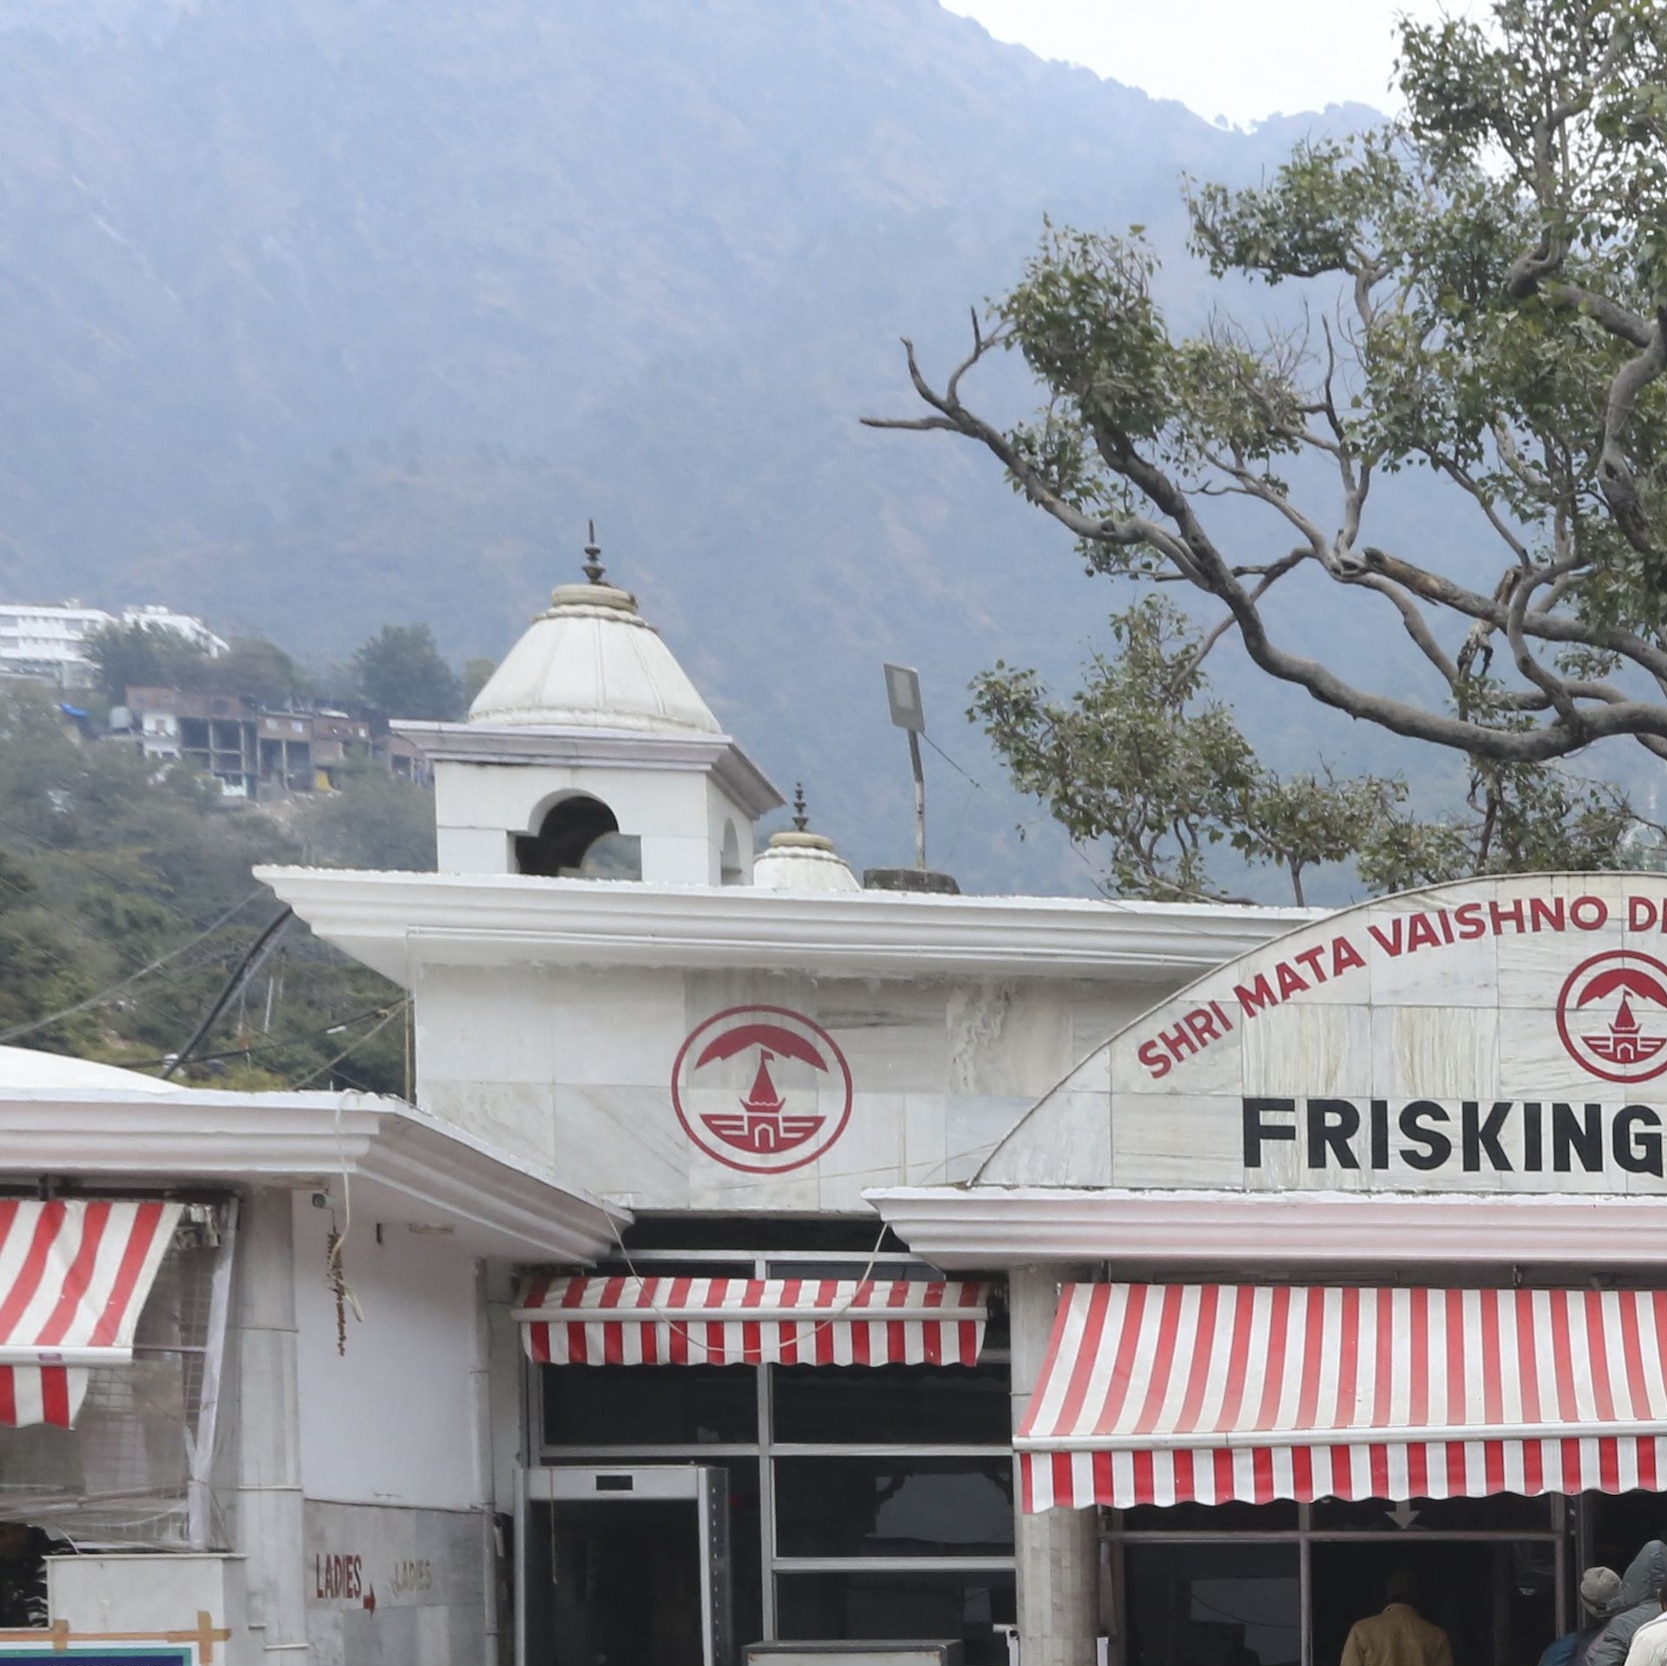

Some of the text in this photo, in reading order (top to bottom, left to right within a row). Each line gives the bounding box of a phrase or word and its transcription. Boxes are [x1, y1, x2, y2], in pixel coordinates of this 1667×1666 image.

[1138, 1001, 1232, 1079] SHRI
[1234, 936, 1365, 1018] MATA
[1368, 895, 1608, 957] VAISHNO
[1243, 1098, 1663, 1178] FRISKING
[316, 1553, 362, 1599] LADIES
